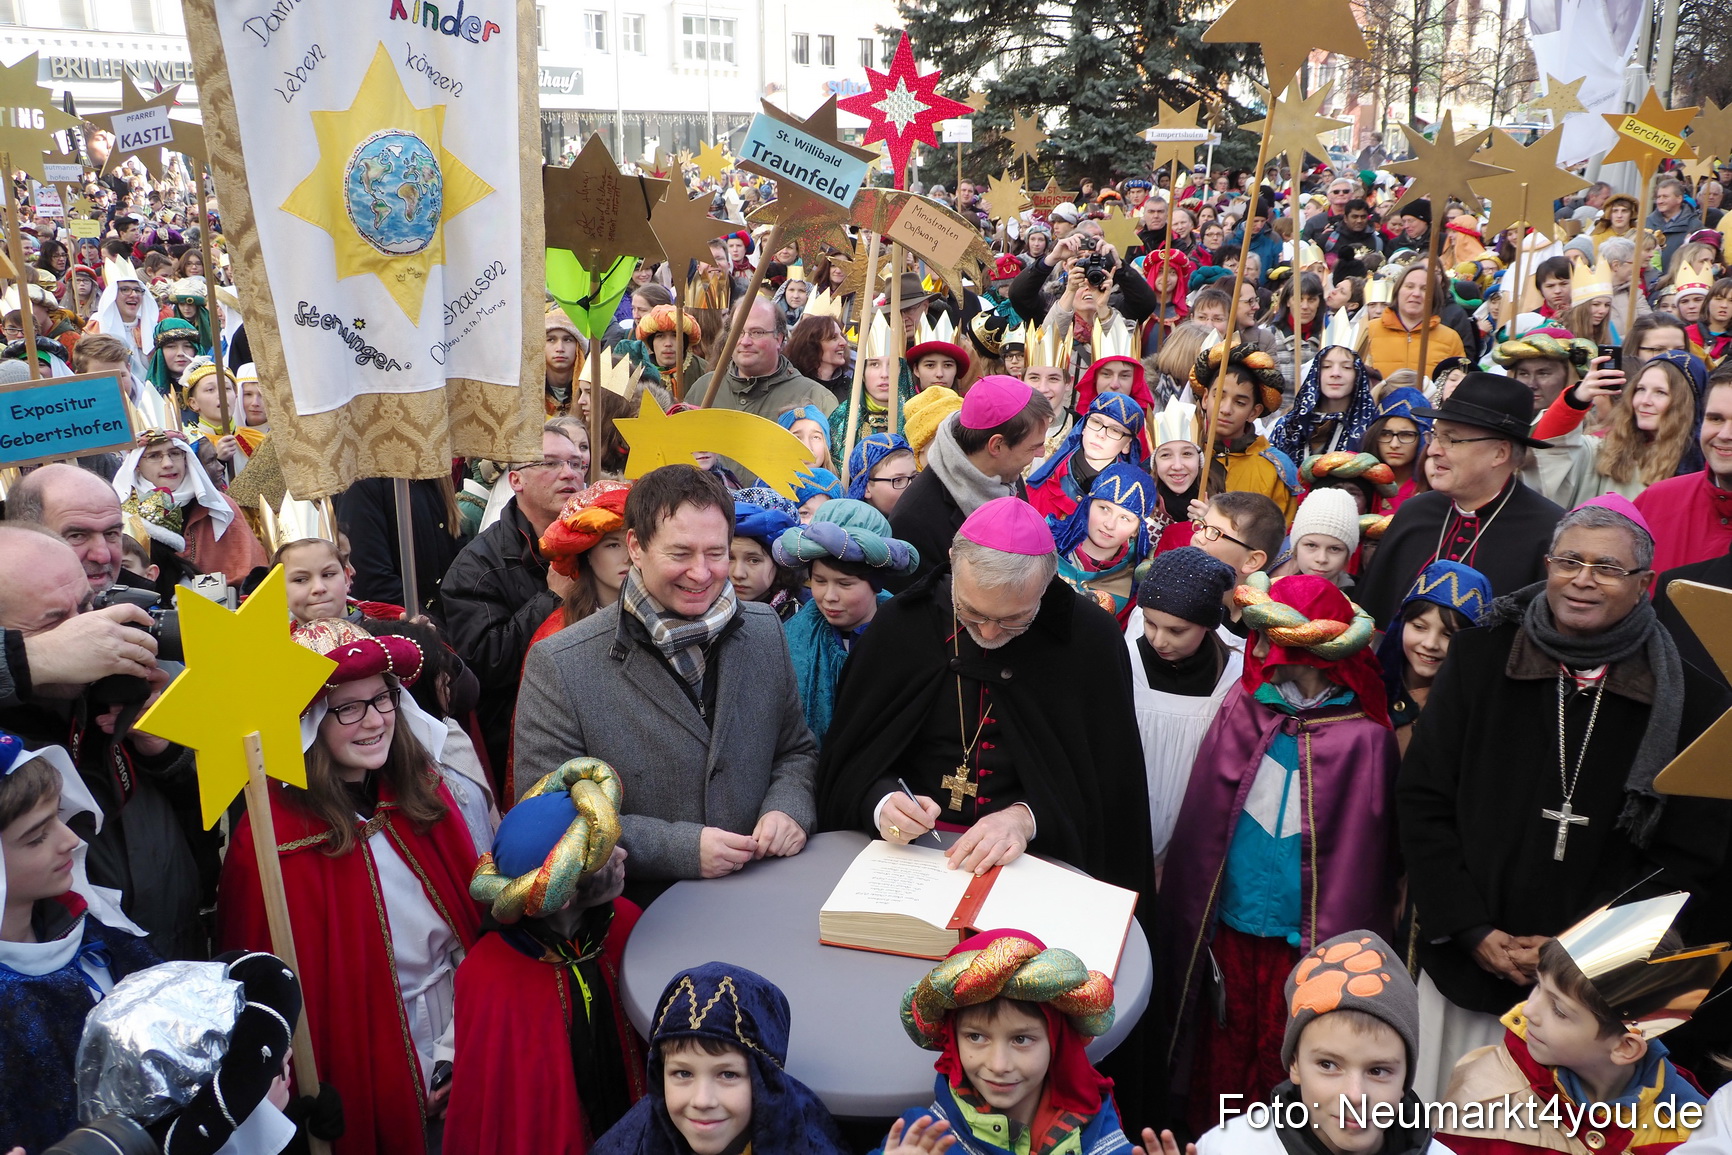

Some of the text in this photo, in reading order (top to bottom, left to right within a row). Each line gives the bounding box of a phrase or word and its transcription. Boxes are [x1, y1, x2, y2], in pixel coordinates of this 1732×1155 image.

[50, 56, 142, 80] BRILLEN
[274, 43, 328, 104] Leben
[126, 110, 156, 123] PFARREI
[121, 125, 170, 149] KASTL
[776, 129, 843, 168] St. Willibald
[1151, 131, 1204, 139] Lampertshofen
[1625, 119, 1677, 153] Berching
[751, 140, 850, 201] Traunfeld
[904, 220, 939, 252] Daßwang
[911, 204, 959, 240] Ministranten
[475, 299, 506, 321] Morus
[10, 397, 97, 420] Expositur
[0, 419, 123, 449] Gebertshofen
[113, 744, 131, 791] Canon
